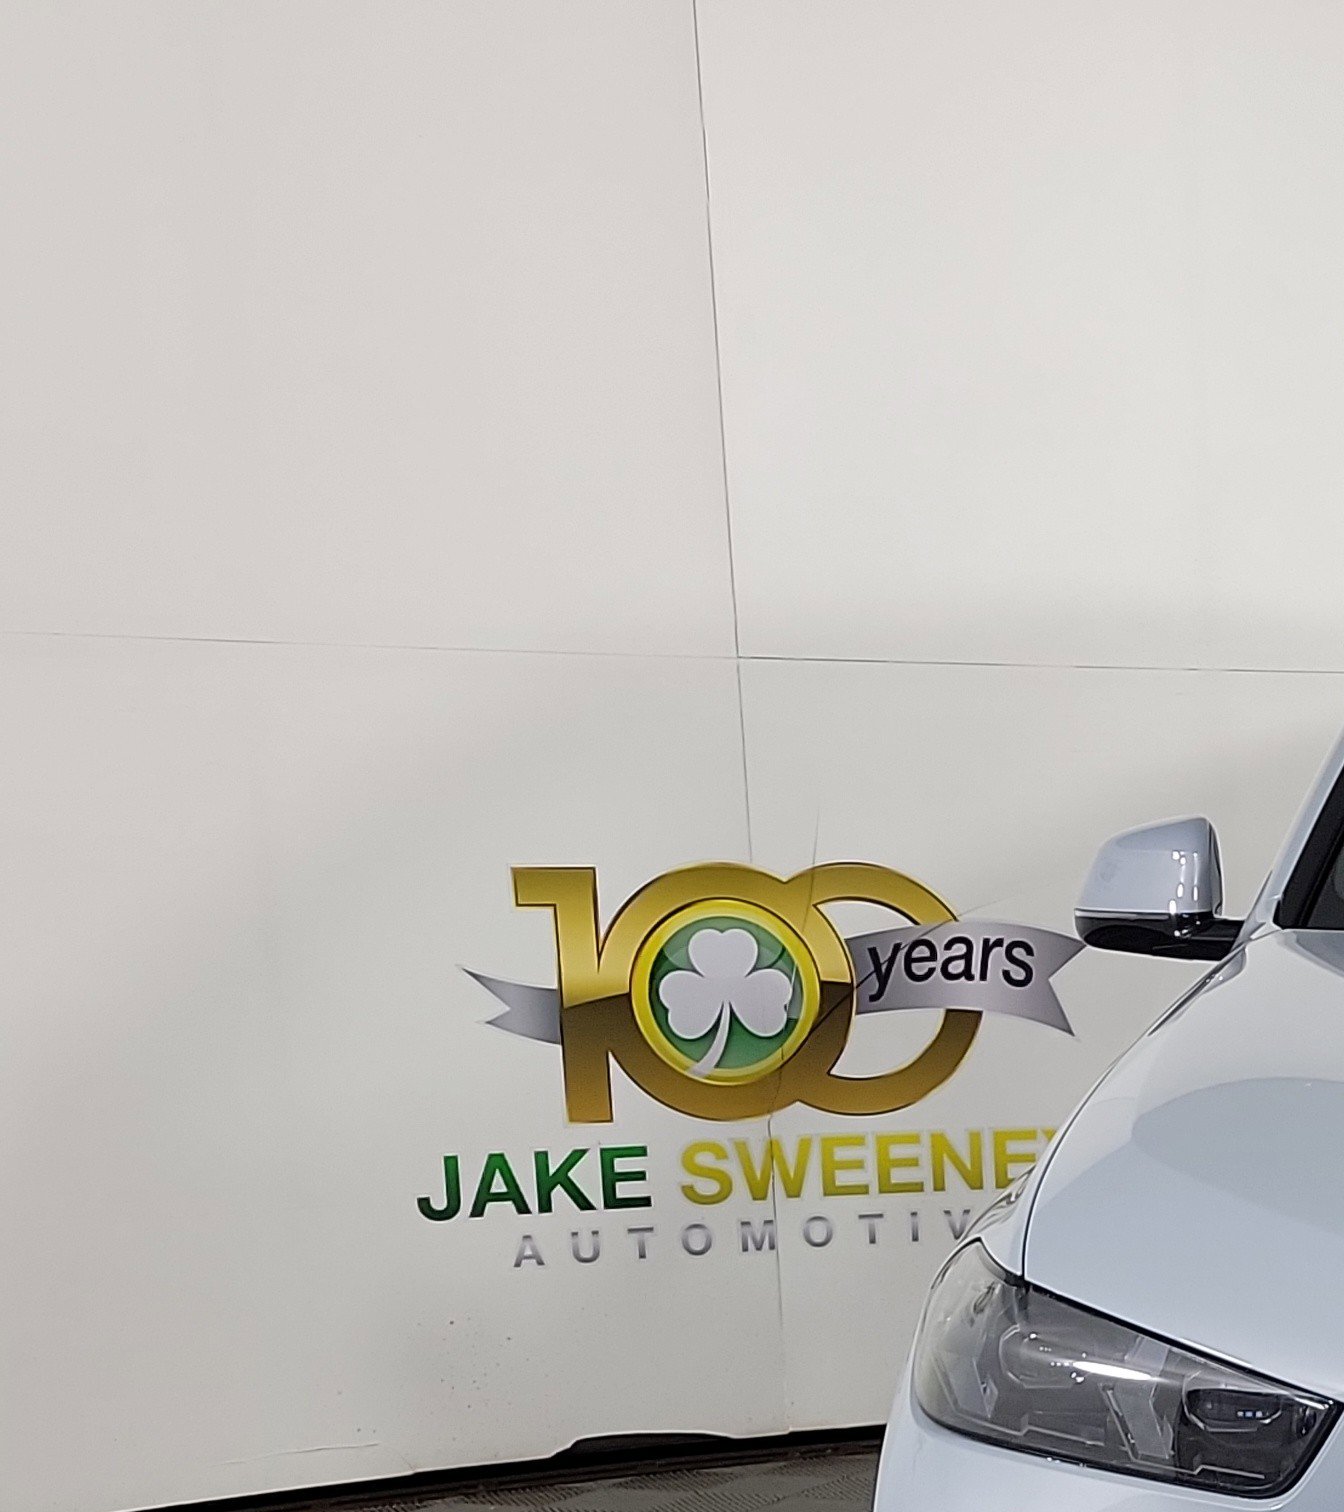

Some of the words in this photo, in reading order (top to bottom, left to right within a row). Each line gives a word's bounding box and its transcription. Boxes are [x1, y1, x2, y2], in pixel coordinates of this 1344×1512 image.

[868, 935, 1035, 1001] years
[416, 1145, 652, 1221] JAKE
[680, 1128, 1057, 1205] SWEENE
[512, 1209, 972, 1268] AUTOMOTIV
